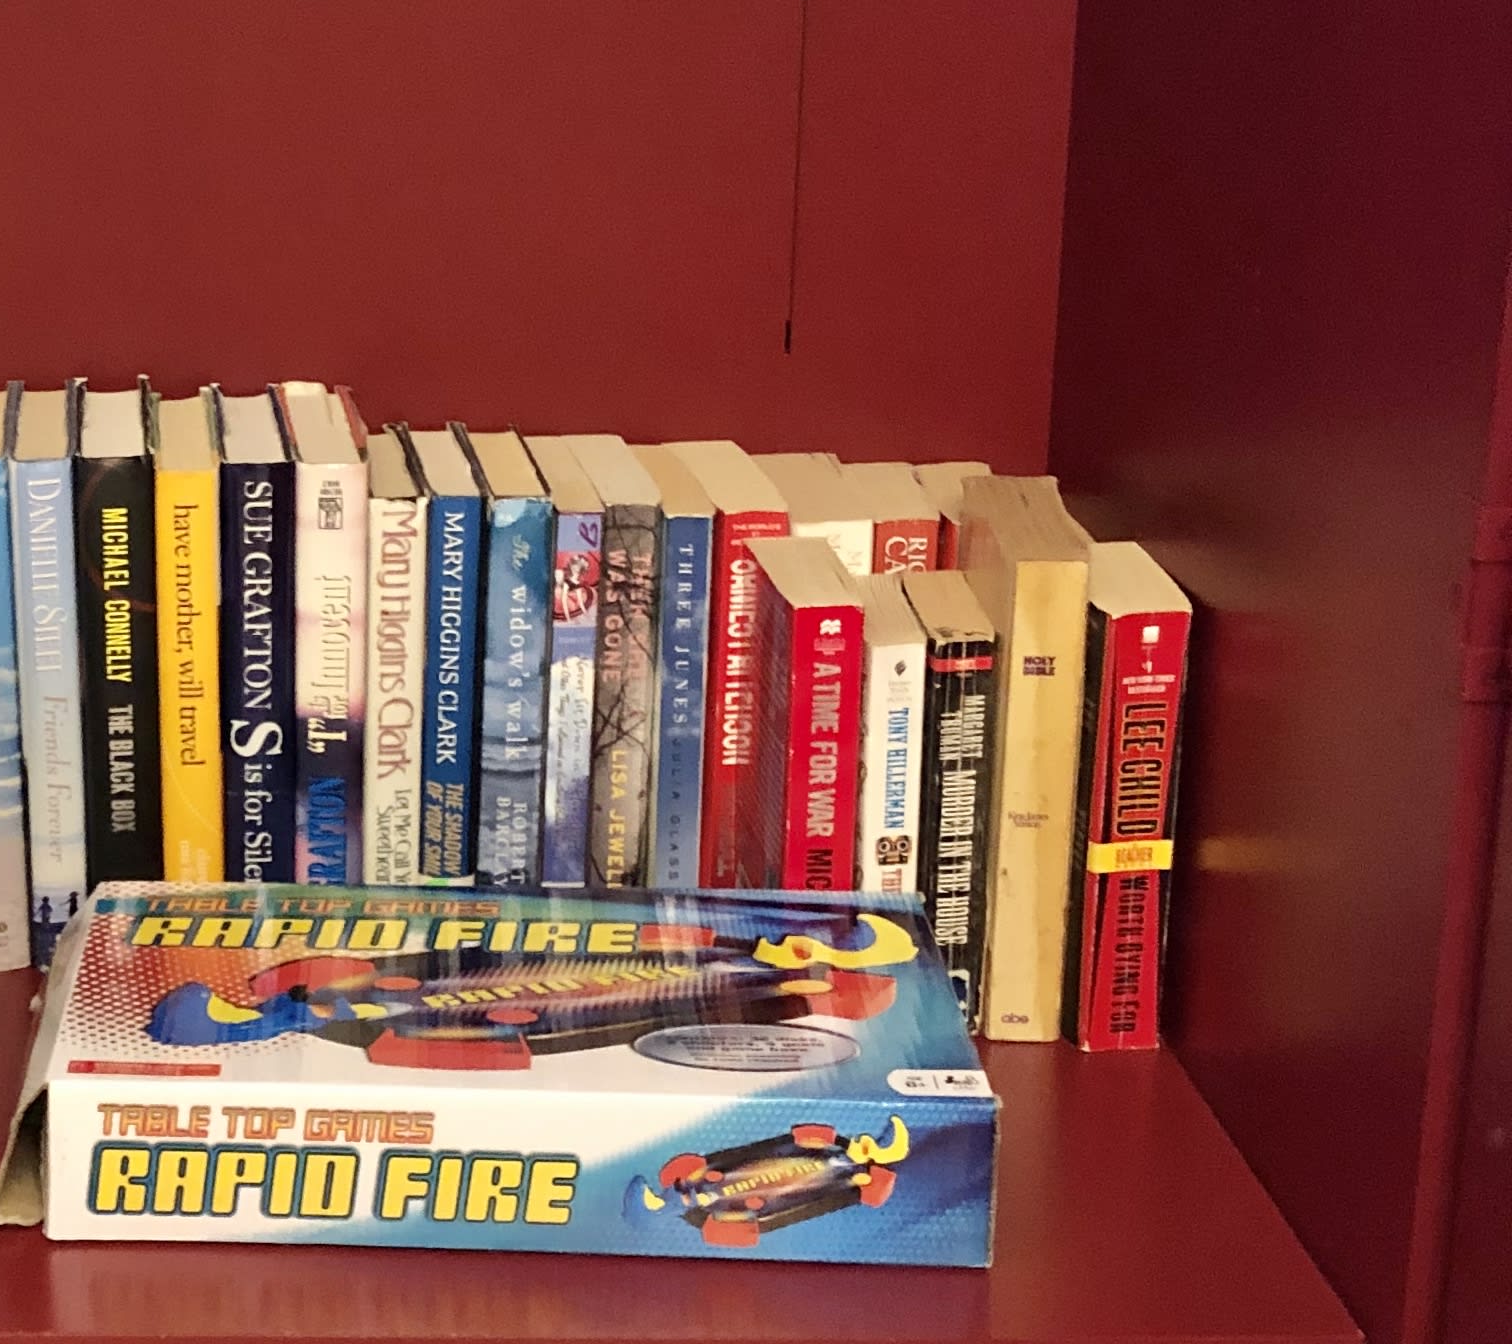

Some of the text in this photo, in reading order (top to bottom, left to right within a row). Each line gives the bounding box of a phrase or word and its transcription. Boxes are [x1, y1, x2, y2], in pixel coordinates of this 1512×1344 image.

[27, 478, 62, 674] DANIELLE STEEL
[100, 507, 131, 684] MICHAEL CONNELLY
[242, 481, 274, 711] SUE GRAFTON
[602, 549, 629, 684] WAS GONE
[172, 504, 206, 767] have mother, will travel
[313, 573, 352, 691] Innocent
[376, 510, 418, 780] Mary Higgins Clark
[434, 511, 466, 766] MARY HIGGINS CLARK
[504, 534, 534, 762] The widow's walk
[672, 543, 695, 725] THREE JUNES
[812, 662, 841, 678] A
[1022, 666, 1057, 676] BIBLE
[1023, 656, 1057, 666] HOLY
[809, 680, 840, 734] TIME
[886, 707, 910, 744] TONY
[938, 710, 962, 761] TRUMAN
[960, 695, 987, 758] MARGARET
[42, 696, 74, 864] Friends Forever
[107, 704, 136, 834] THE BLACK BOX
[229, 719, 284, 826] S is for
[609, 748, 629, 800] LISA
[808, 740, 839, 786] FOR
[883, 748, 908, 829] HILLERMAN
[1115, 702, 1168, 836] LEE CHILD
[394, 788, 413, 869] Let Me Call
[424, 780, 444, 842] OF YOUR
[442, 783, 465, 877] THE SHADOW
[493, 795, 512, 888] BARCLAY
[510, 802, 528, 885] ROBERT
[668, 738, 682, 882] JULIA GLASS
[805, 788, 838, 839] WAR
[934, 769, 978, 946] MURDER IN THE HOUSE
[131, 917, 638, 953] RAPID FIRE
[144, 899, 501, 917] TABLE TOP GAMES
[420, 973, 584, 1010] RAPID
[1108, 875, 1150, 1036] WORTH DYING FOR
[96, 1103, 435, 1145] TABLE TOP GAMES
[93, 1145, 580, 1225] RAPID FIRE
